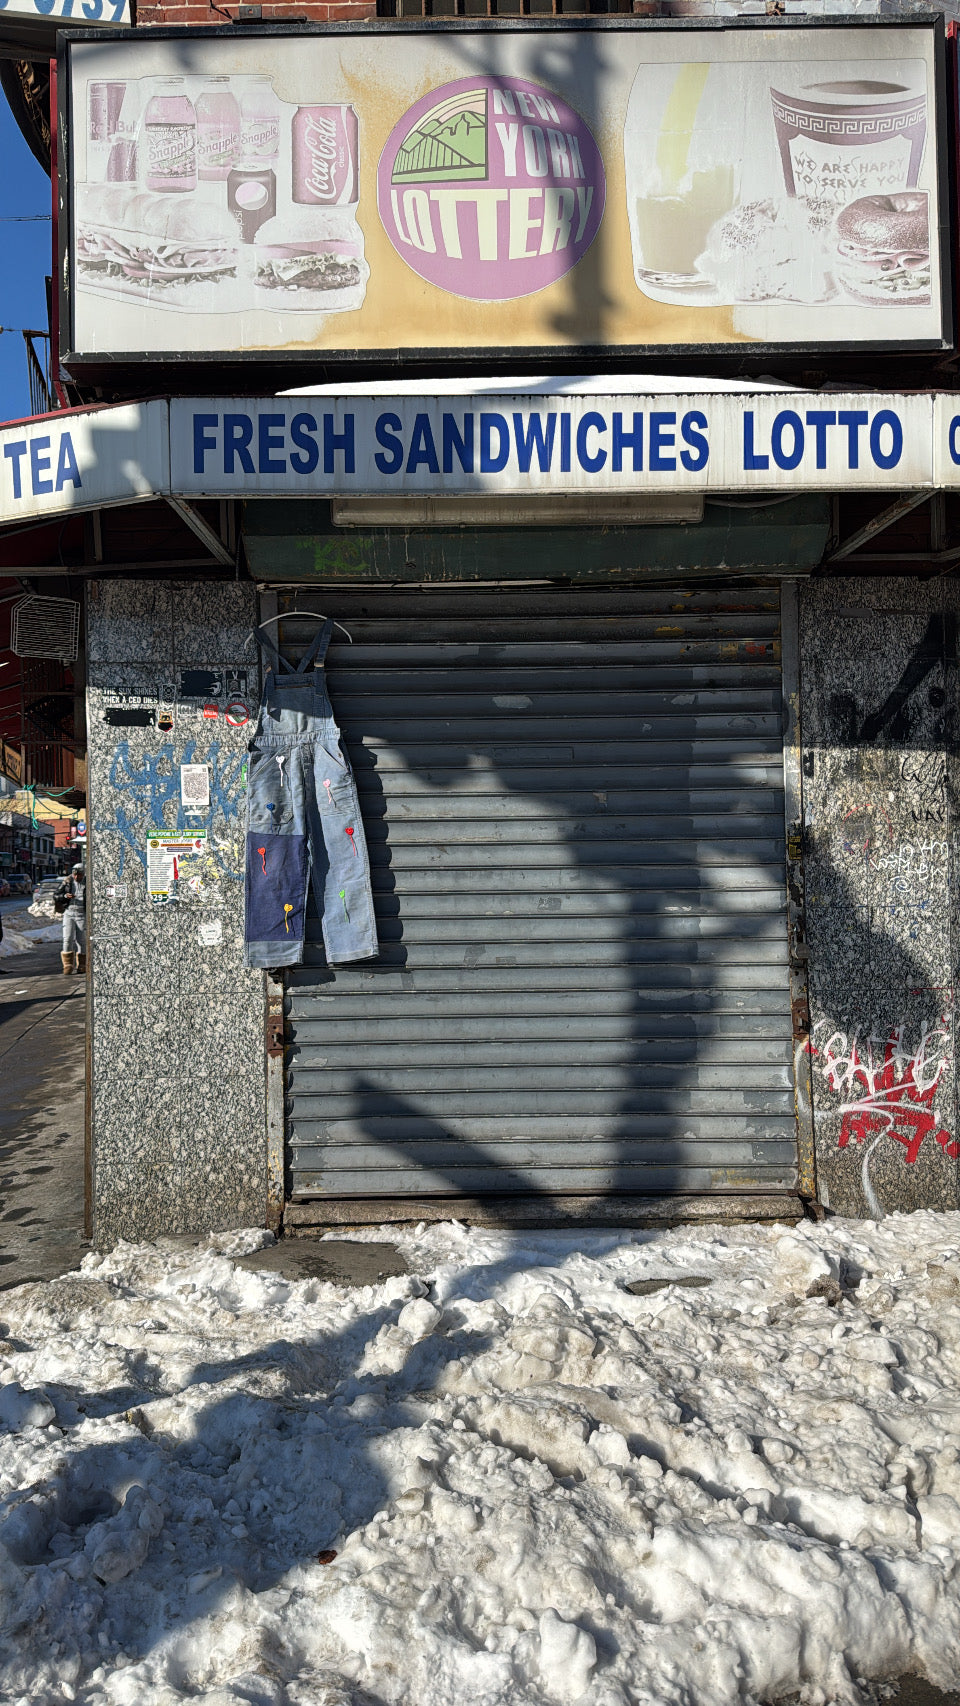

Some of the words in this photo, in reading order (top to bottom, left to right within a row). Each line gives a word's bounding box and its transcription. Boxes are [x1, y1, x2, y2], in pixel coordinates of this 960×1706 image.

[493, 89, 560, 124] NEW
[198, 132, 238, 154] Snapple
[241, 125, 278, 145] Snapple
[495, 123, 585, 179] YORK
[794, 156, 817, 170] WE
[822, 163, 851, 174] ARE
[860, 158, 905, 174] HAPPY
[795, 171, 813, 184] TO
[821, 178, 867, 189] SERVE
[876, 173, 905, 187] YOU
[391, 186, 594, 261] LOTTERY
[193, 413, 355, 475] FRESH
[375, 410, 710, 475] SANDWICHES
[743, 409, 903, 471] LOTTO
[4, 432, 82, 499] TEA
